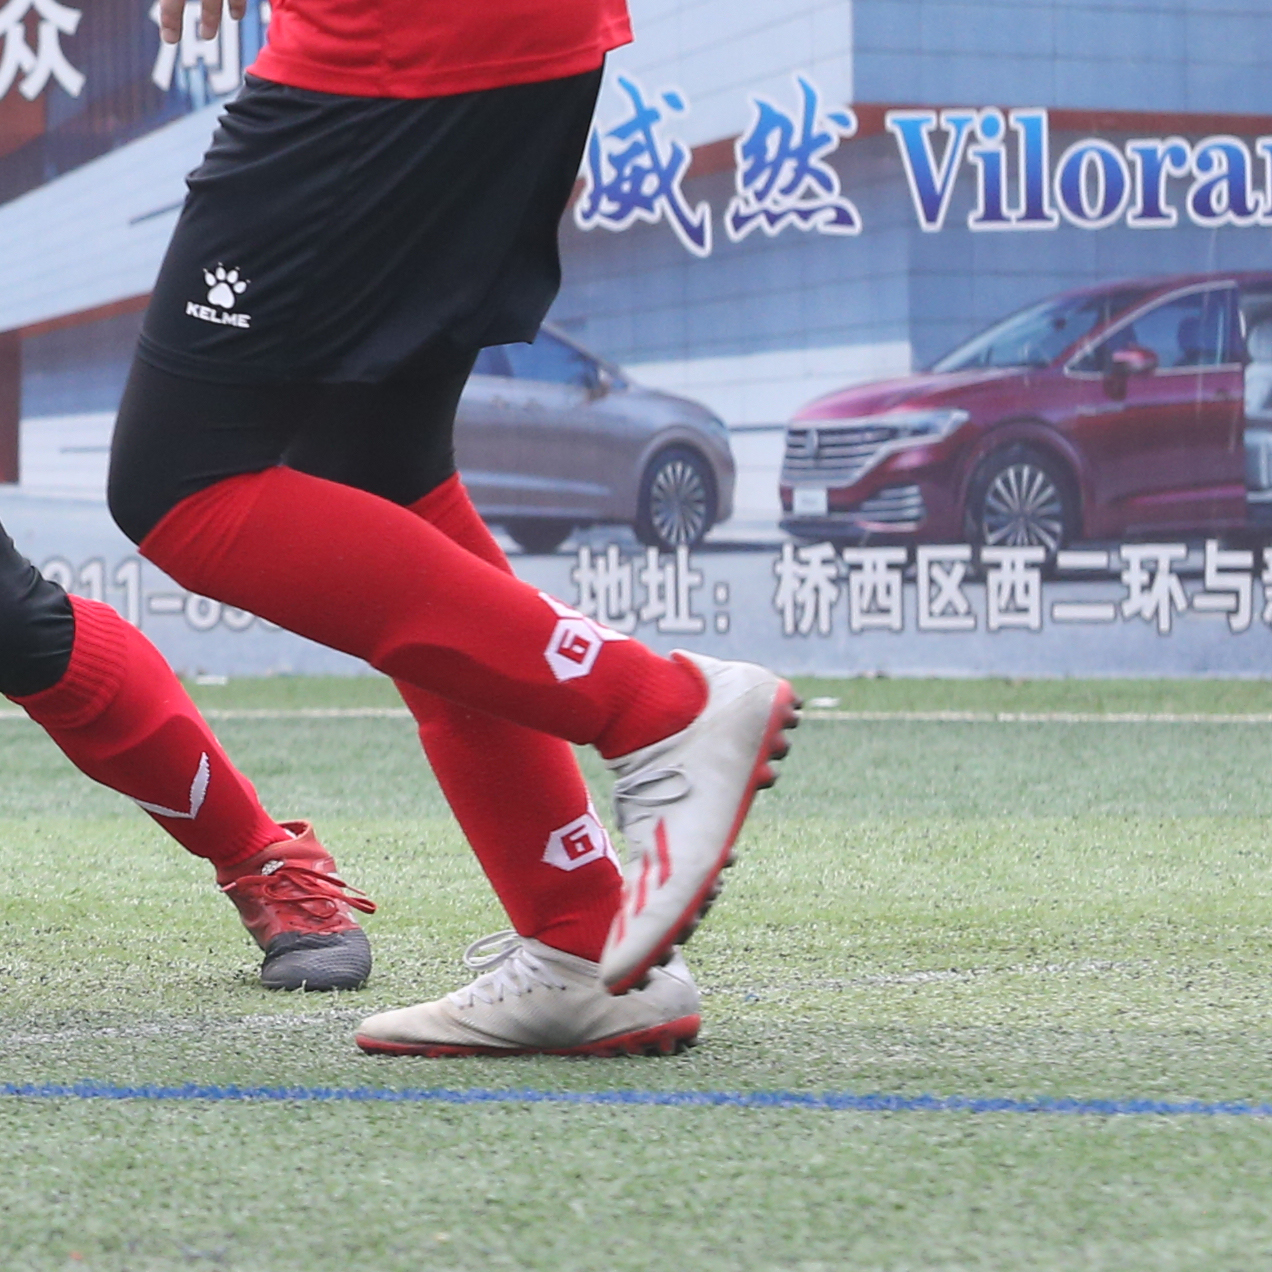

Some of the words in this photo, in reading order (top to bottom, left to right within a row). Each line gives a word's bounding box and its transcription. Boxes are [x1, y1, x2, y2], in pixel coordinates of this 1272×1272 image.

[574, 71, 861, 258] 威然
[185, 301, 252, 329] KELME
[572, 539, 1272, 634] 地址：桥西区西二环与
